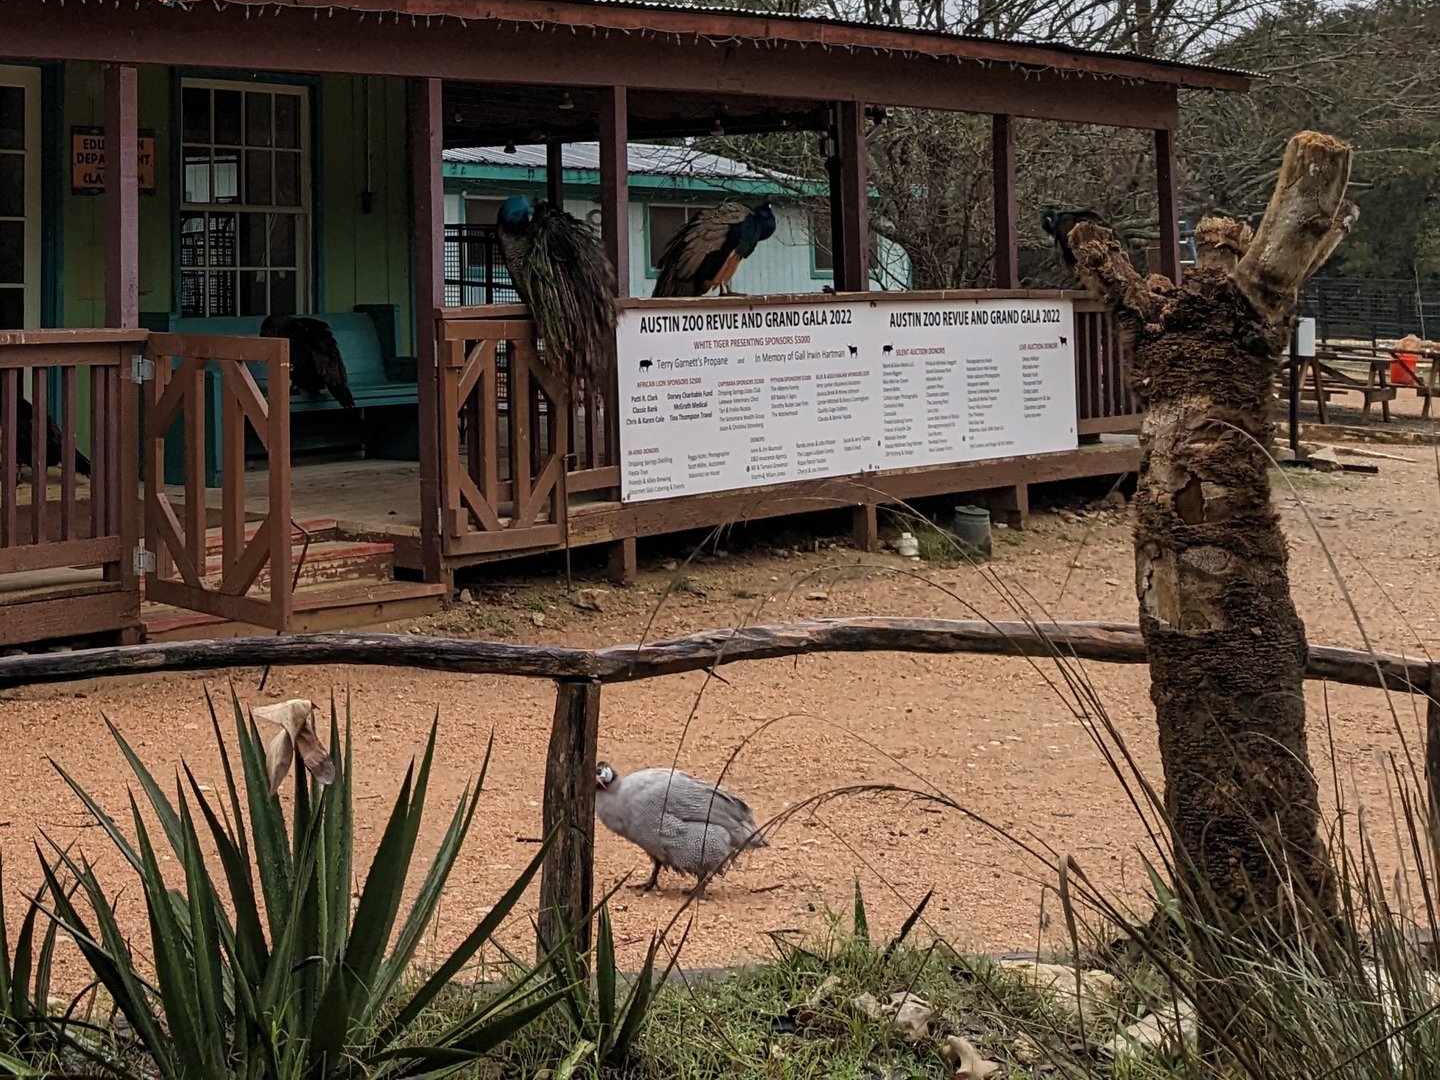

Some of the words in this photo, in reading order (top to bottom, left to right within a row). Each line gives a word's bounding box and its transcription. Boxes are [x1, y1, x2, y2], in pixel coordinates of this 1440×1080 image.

[77, 153, 150, 165] DEPANT
[640, 315, 680, 333] AUSTIN
[682, 314, 704, 331] ZOO
[706, 313, 739, 330] REVUE
[741, 312, 763, 329] AND
[765, 311, 800, 328] GRAND
[802, 310, 828, 326] GALA
[830, 309, 852, 325] 2022
[890, 312, 922, 328] AUSTIN
[923, 311, 940, 327] ZOO
[943, 310, 969, 326] REVUE
[971, 310, 988, 325] AND
[990, 309, 1019, 325] GRAND
[1020, 309, 1041, 323] GALA
[1042, 308, 1060, 323] 2022
[693, 340, 712, 349] WHITE
[713, 339, 729, 348] TIGER
[730, 338, 764, 348] PRESENTING
[765, 336, 794, 346] SPONSORS
[755, 354, 761, 362] In
[762, 353, 786, 363] Memory
[787, 351, 794, 360] of
[807, 351, 821, 359] Irwin
[821, 350, 845, 358] Hartman
[657, 359, 673, 370] Terry
[674, 357, 702, 368] Garnett's
[703, 357, 728, 367] Propane
[682, 391, 702, 399] Charitable
